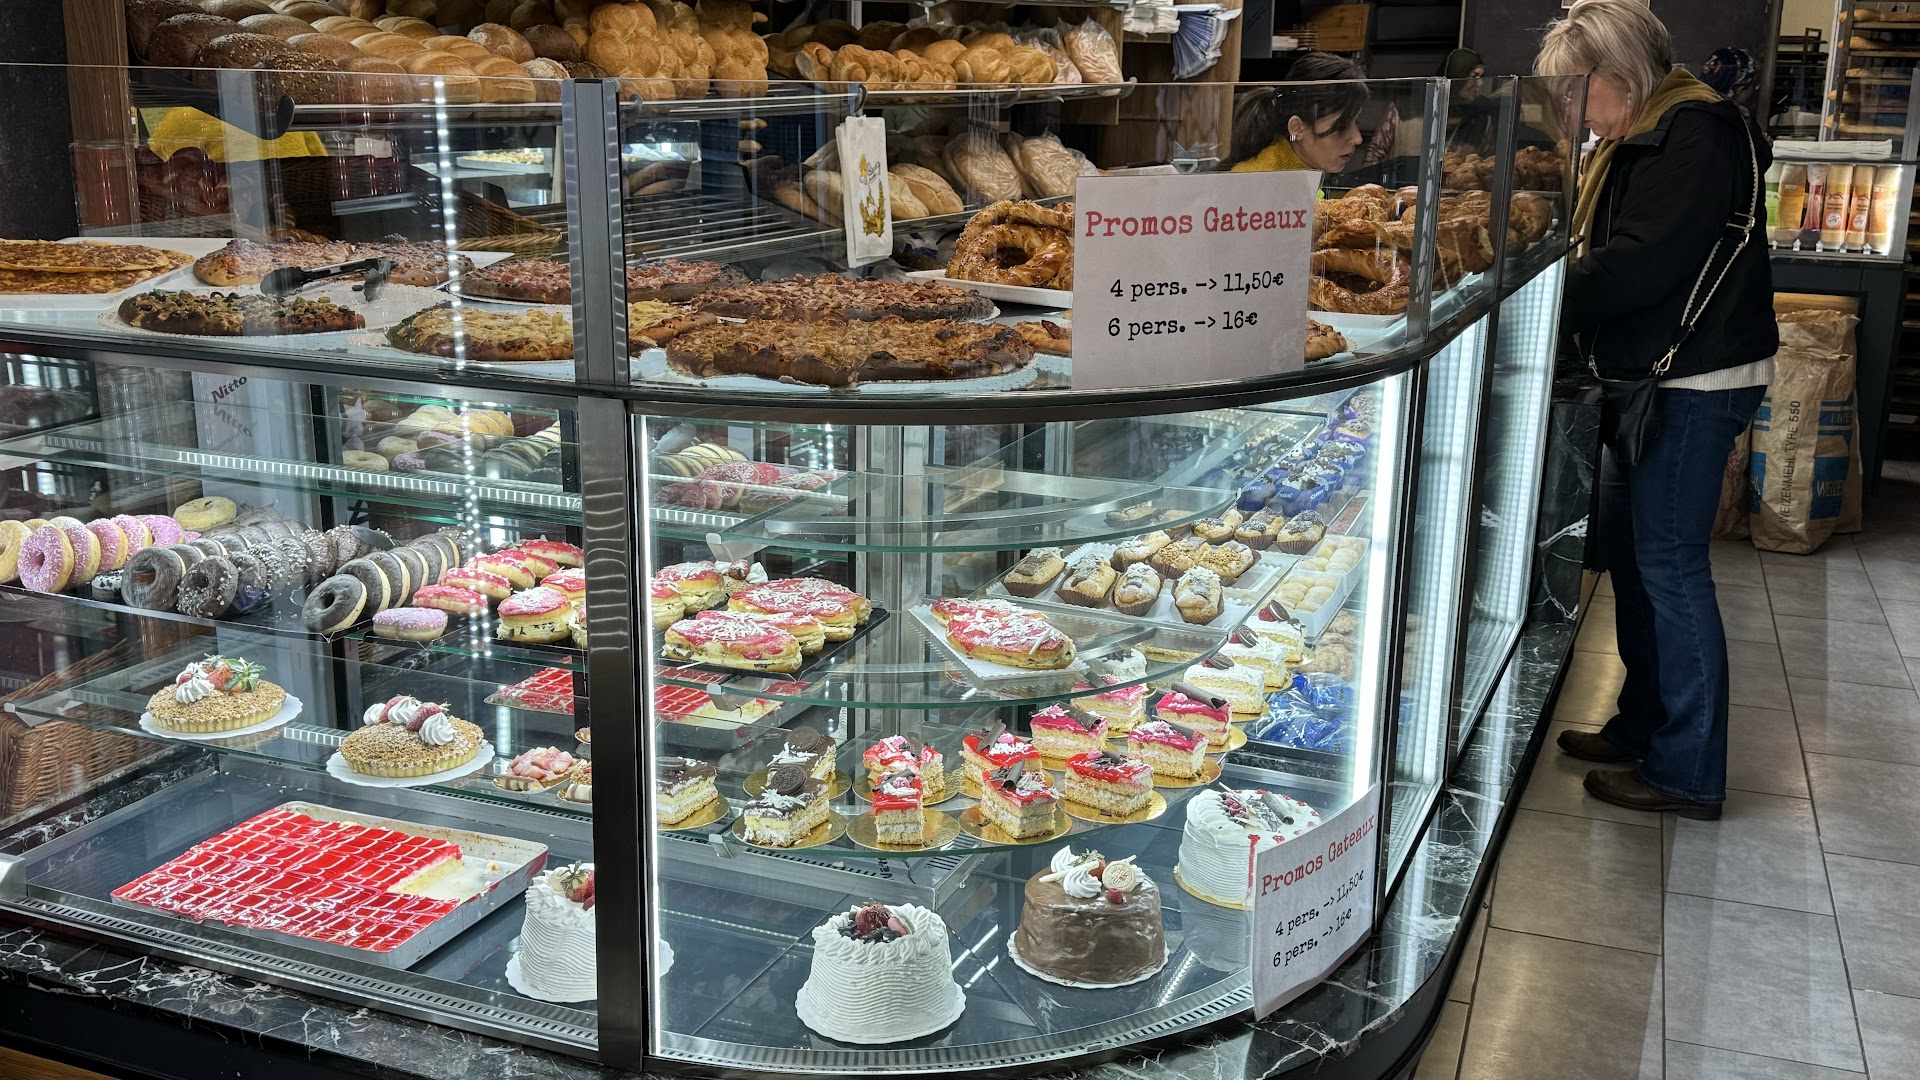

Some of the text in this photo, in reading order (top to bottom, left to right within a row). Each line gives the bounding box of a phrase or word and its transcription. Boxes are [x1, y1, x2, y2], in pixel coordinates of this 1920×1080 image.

[1085, 206, 1308, 237] Promos Gateaux
[1110, 279, 1123, 298] 4
[1130, 280, 1187, 302] pers.
[1107, 318, 1121, 337] 6
[1127, 319, 1186, 341] pers.
[1222, 310, 1258, 330] 16€
[211, 376, 248, 404] Nitto
[1779, 400, 1801, 523] WEIZENMEHL TYPE 550
[1261, 815, 1375, 896] Promos Gateaux
[1275, 920, 1284, 936] 4
[1287, 907, 1320, 936] pers.
[1272, 951, 1281, 967] 6
[1284, 937, 1318, 966] pers.
